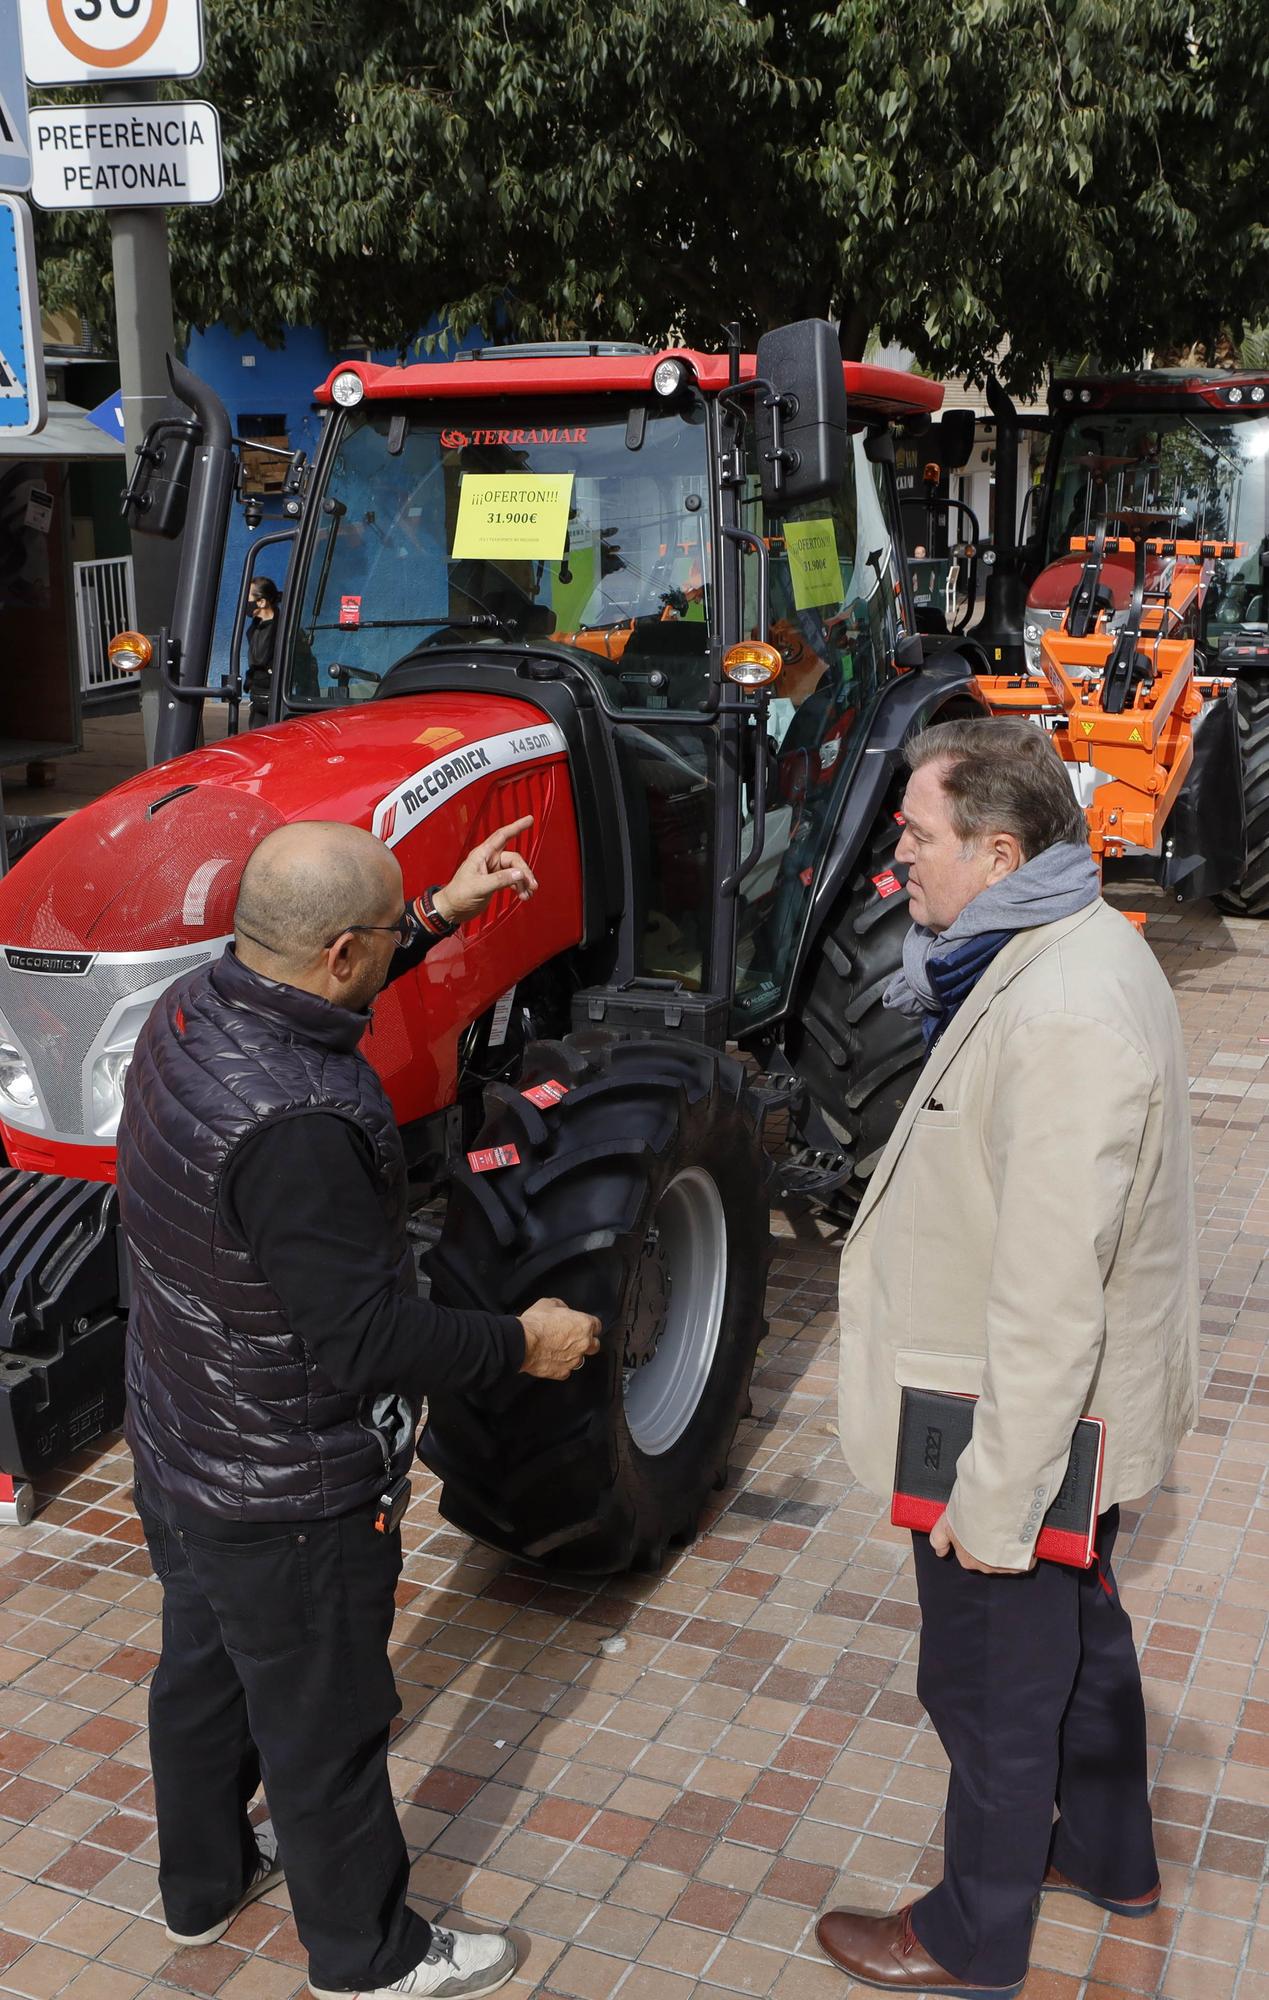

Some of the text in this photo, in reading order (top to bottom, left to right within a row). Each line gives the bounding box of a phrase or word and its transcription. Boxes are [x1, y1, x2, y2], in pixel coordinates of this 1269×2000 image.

[37, 117, 204, 151] PREFERÈNCIA
[63, 162, 186, 191] PEATONAL
[471, 427, 588, 445] TERRAMAR
[487, 512, 538, 524] 31.900€
[924, 1426, 943, 1472] 2021
